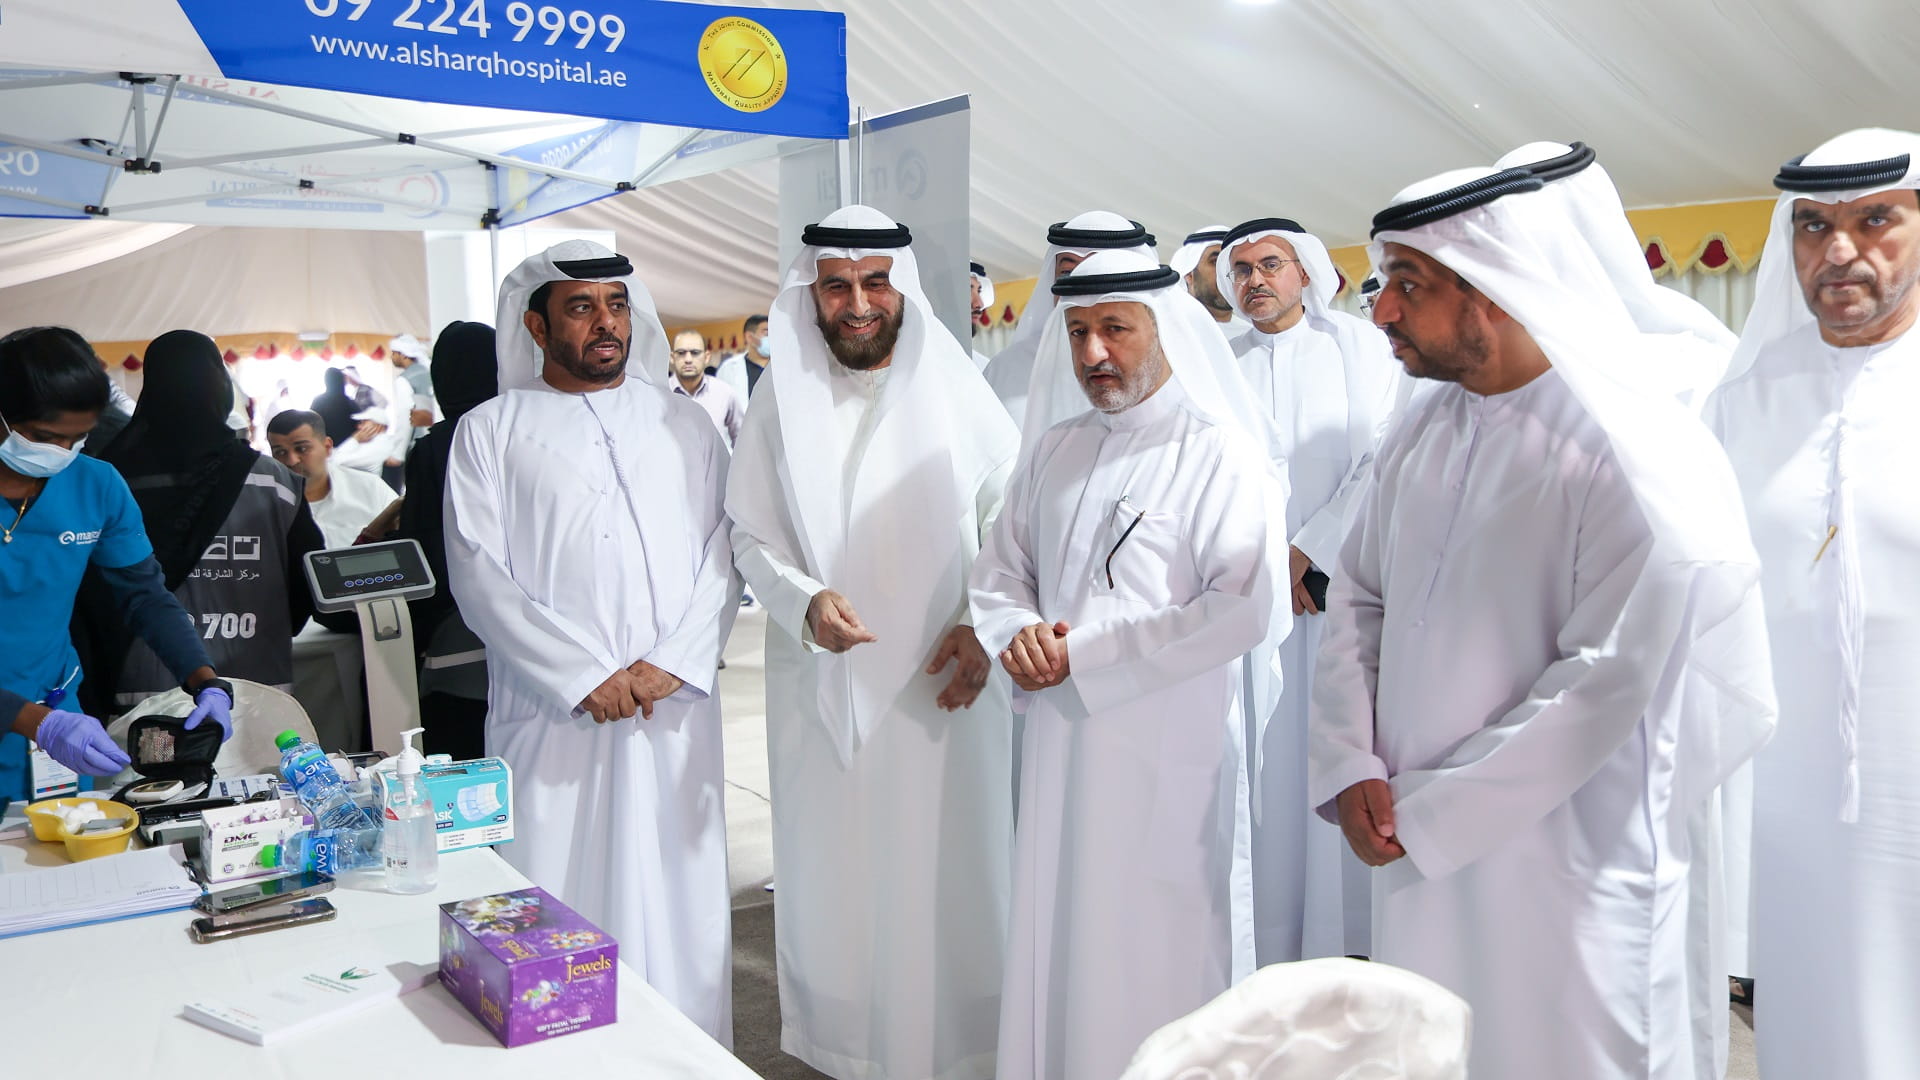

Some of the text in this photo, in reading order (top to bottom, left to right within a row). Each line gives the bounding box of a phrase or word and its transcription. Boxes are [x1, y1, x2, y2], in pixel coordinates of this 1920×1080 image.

[392, 0, 491, 38] 224
[505, 1, 626, 53] 9999
[310, 33, 628, 88] www.alsharqhospital.ae
[706, 70, 732, 102] NATIONAL
[202, 612, 257, 639] 700
[224, 831, 258, 844] DMC
